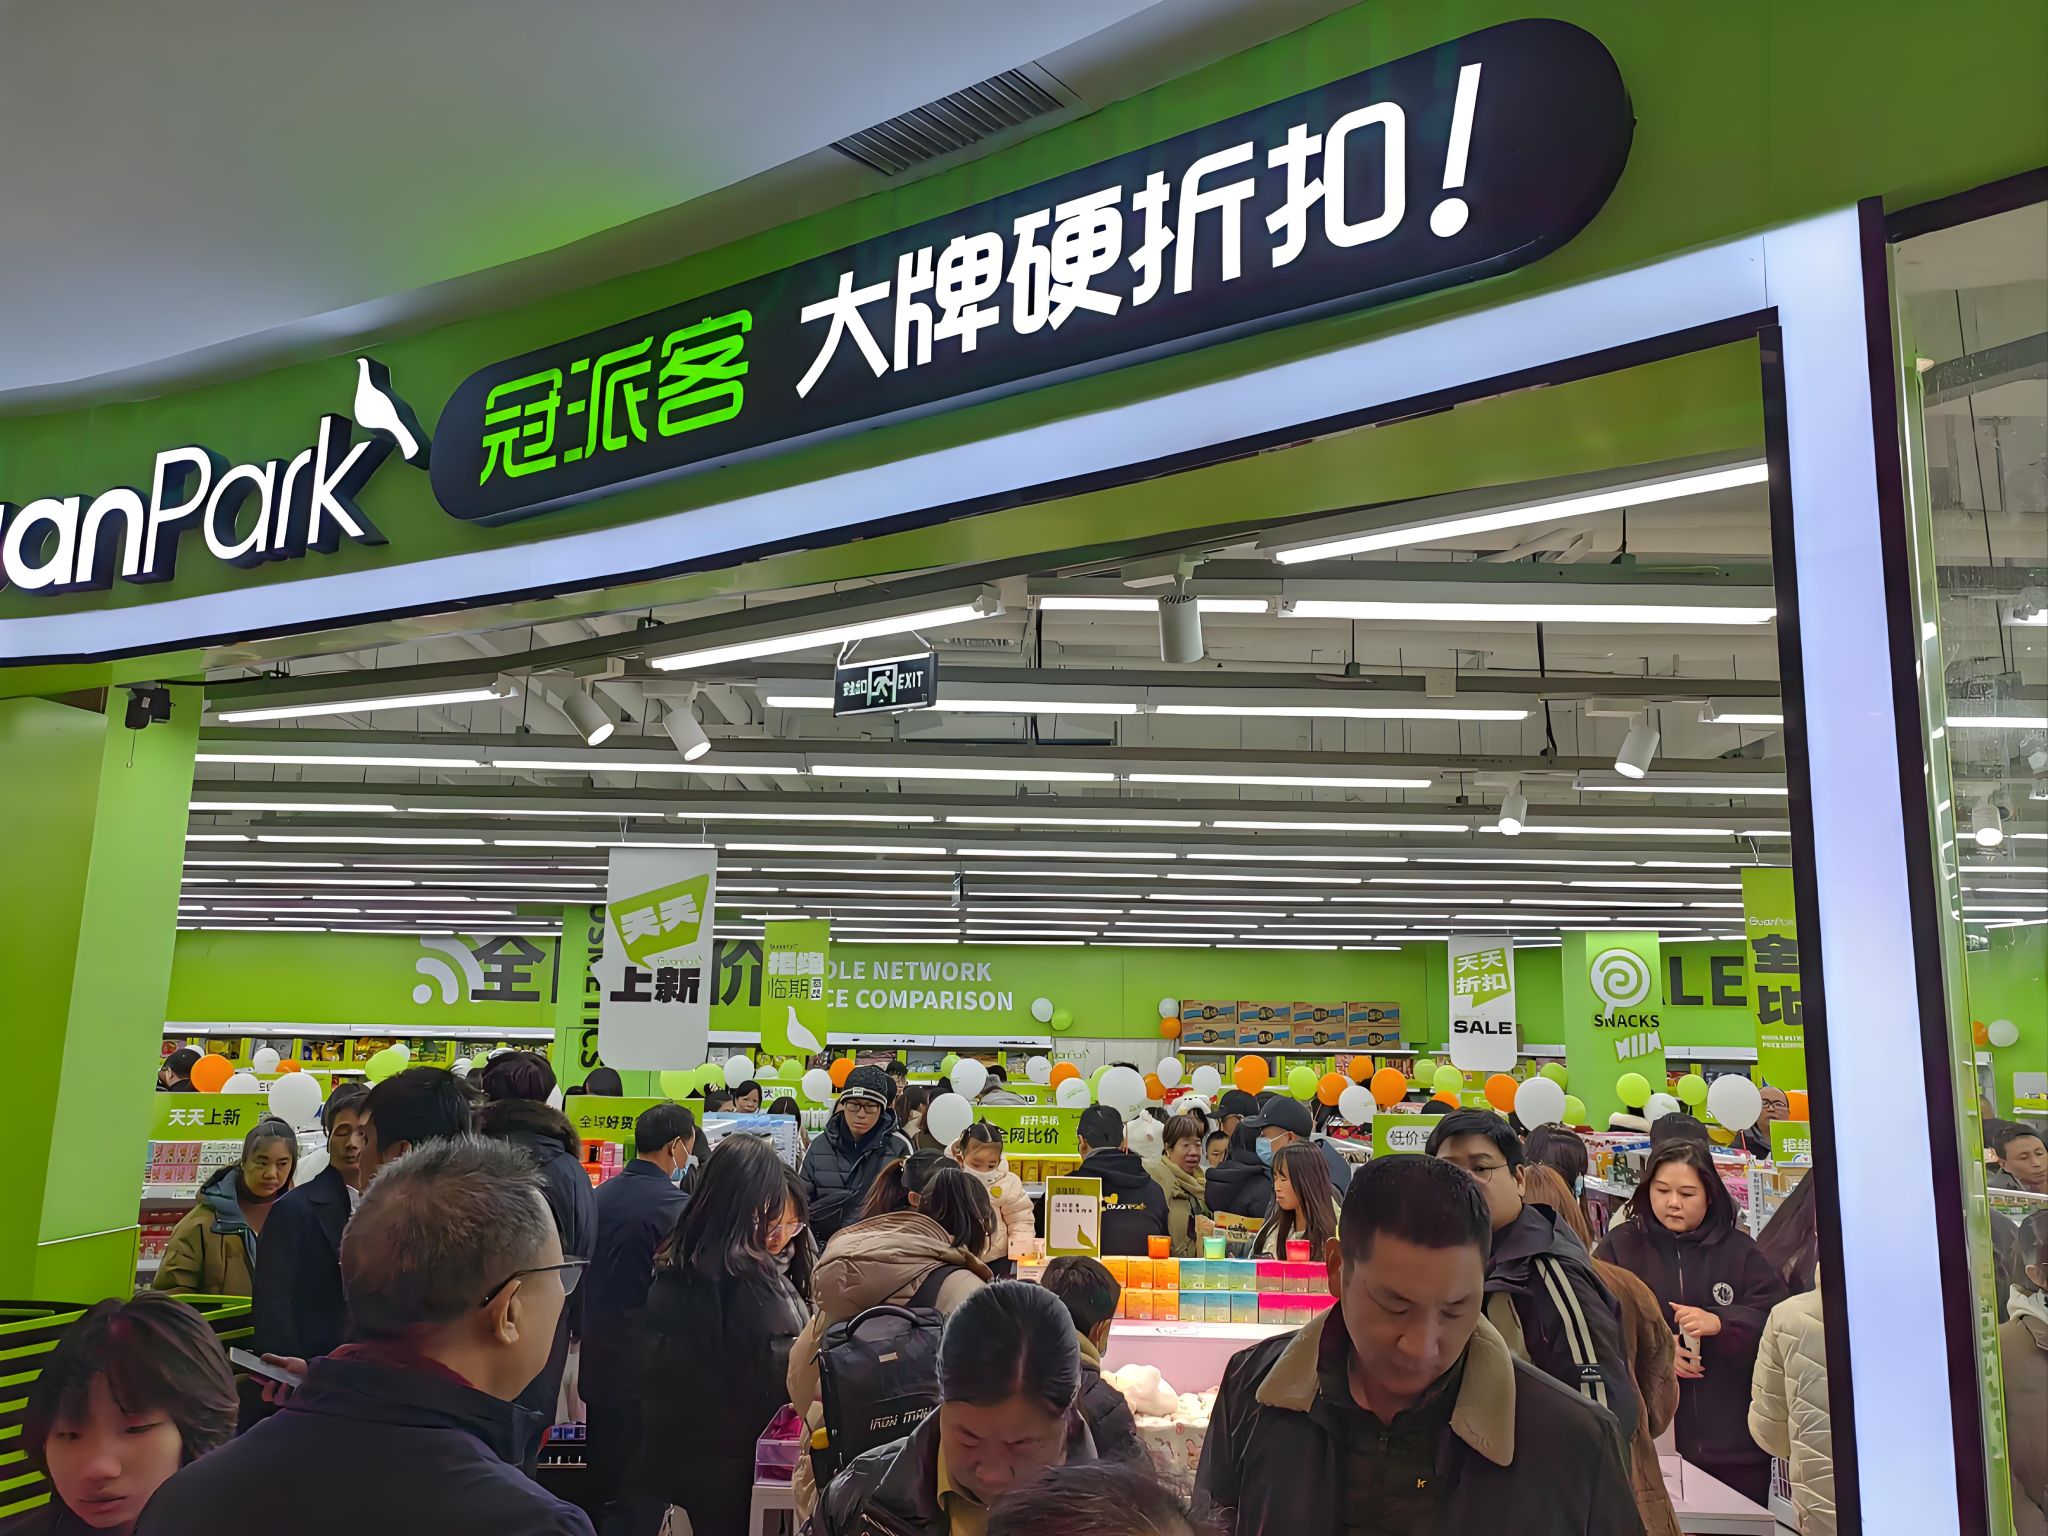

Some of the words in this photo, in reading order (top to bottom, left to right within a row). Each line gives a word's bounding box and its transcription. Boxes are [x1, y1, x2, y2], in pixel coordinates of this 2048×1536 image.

[480, 309, 753, 487] 冠派客
[0, 415, 371, 593] anPark
[898, 670, 924, 690] EXIT
[873, 961, 992, 982] NETWORK
[1456, 950, 1504, 974] 天天
[610, 966, 700, 1004] 上新
[768, 977, 809, 999] 临期
[1456, 973, 1507, 994] 折扣
[855, 989, 1013, 1011] COMPARISON
[1454, 1020, 1512, 1035] SALE
[1594, 1014, 1660, 1028] SNACKS
[168, 1108, 241, 1127] 天天上新
